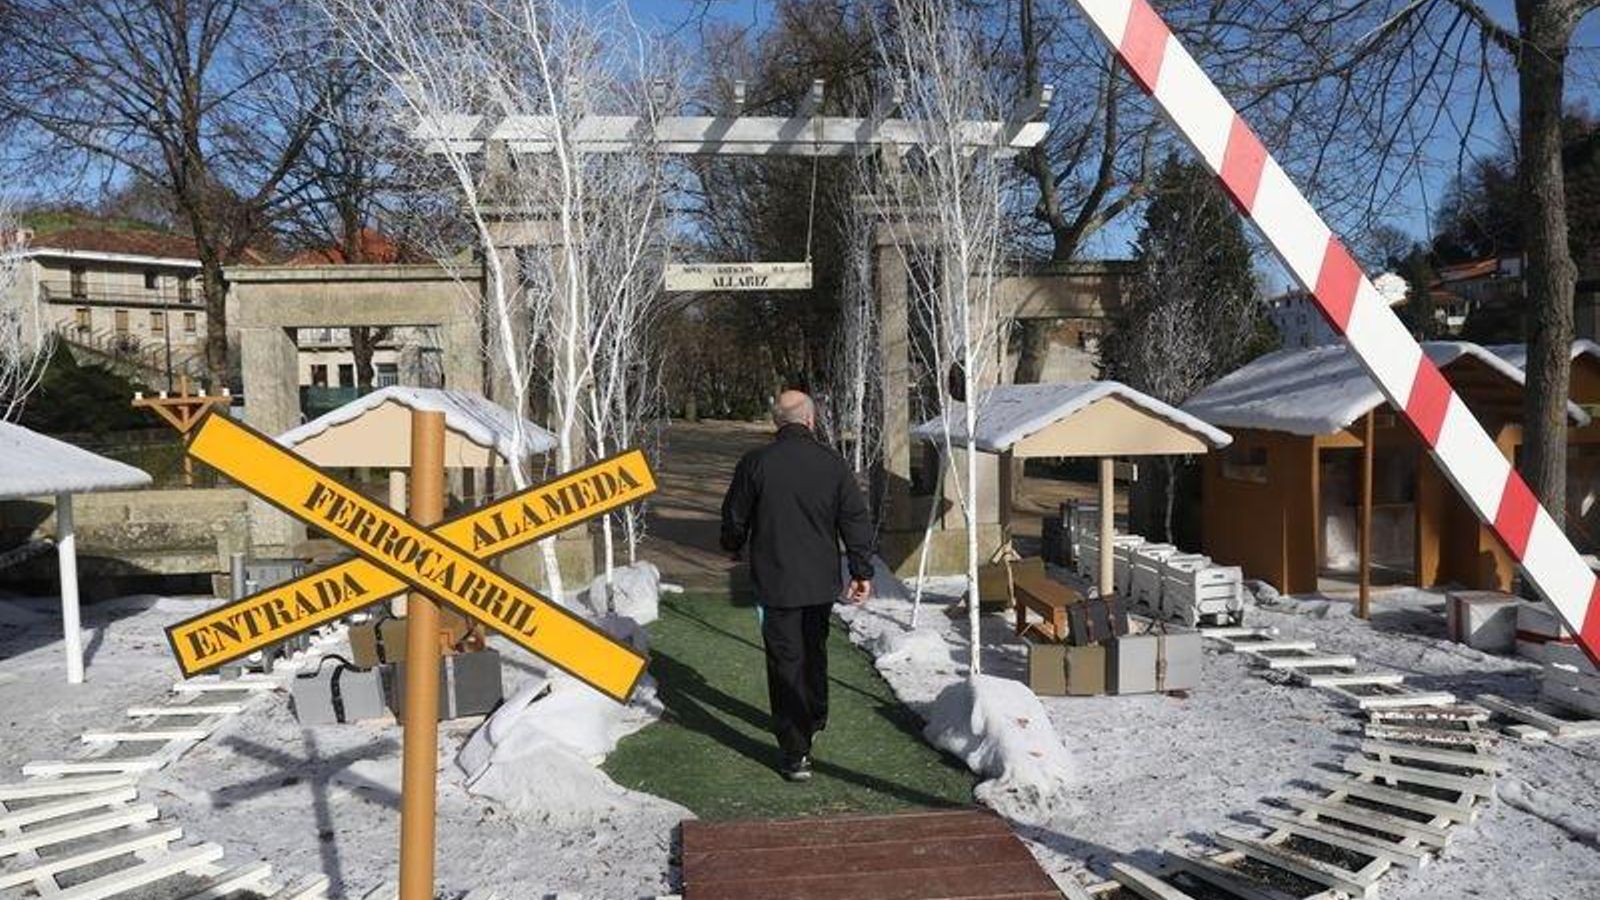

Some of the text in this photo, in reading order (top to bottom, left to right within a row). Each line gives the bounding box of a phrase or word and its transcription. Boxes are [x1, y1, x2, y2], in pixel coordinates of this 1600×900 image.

[713, 276, 768, 287] ALLARIZ
[186, 466, 641, 661] ENTRADA ALAMEDA
[302, 481, 538, 637] FERROCARRIL
